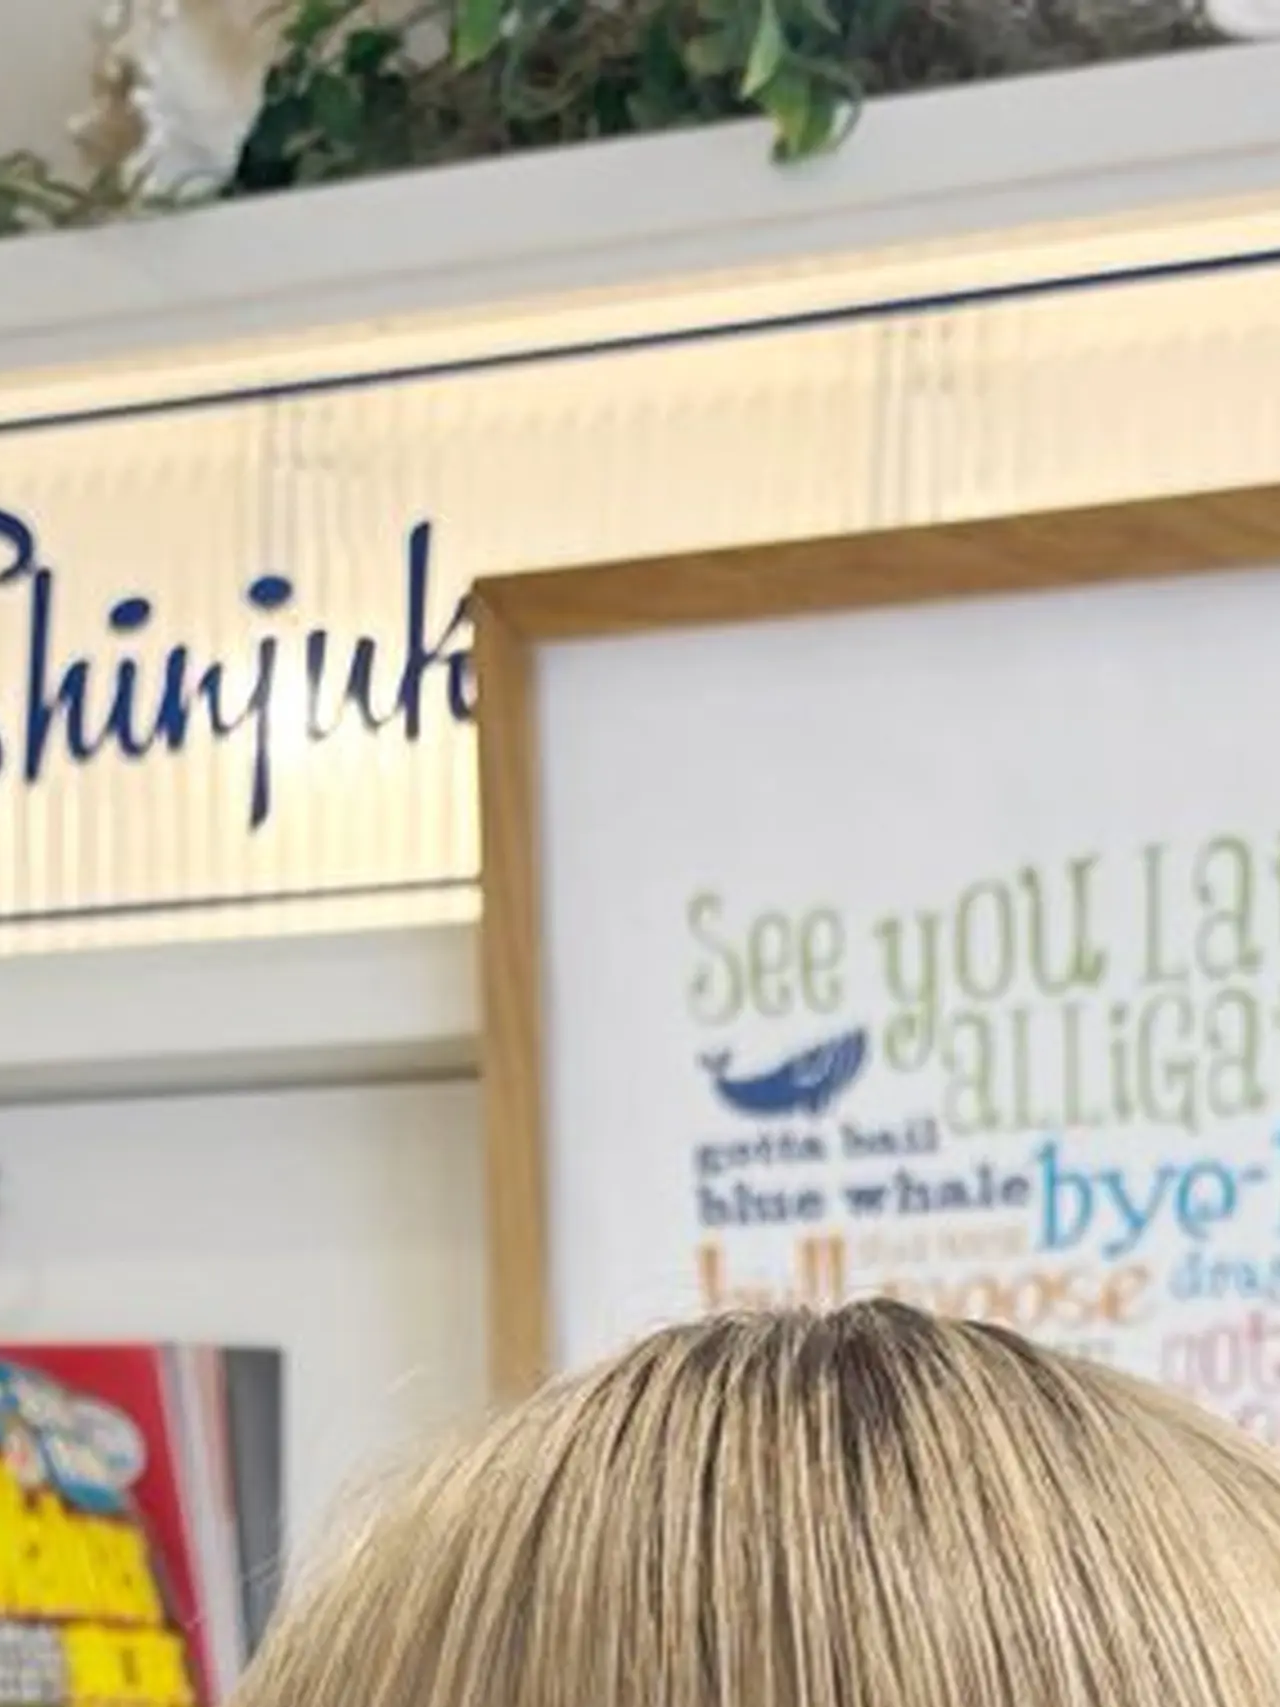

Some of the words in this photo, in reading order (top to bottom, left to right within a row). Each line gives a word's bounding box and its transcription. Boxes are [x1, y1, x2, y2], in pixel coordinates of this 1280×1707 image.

[686, 888, 847, 1026] See
[872, 856, 1108, 1072] you
[697, 1182, 823, 1226] blue
[844, 1160, 1028, 1214] whale
